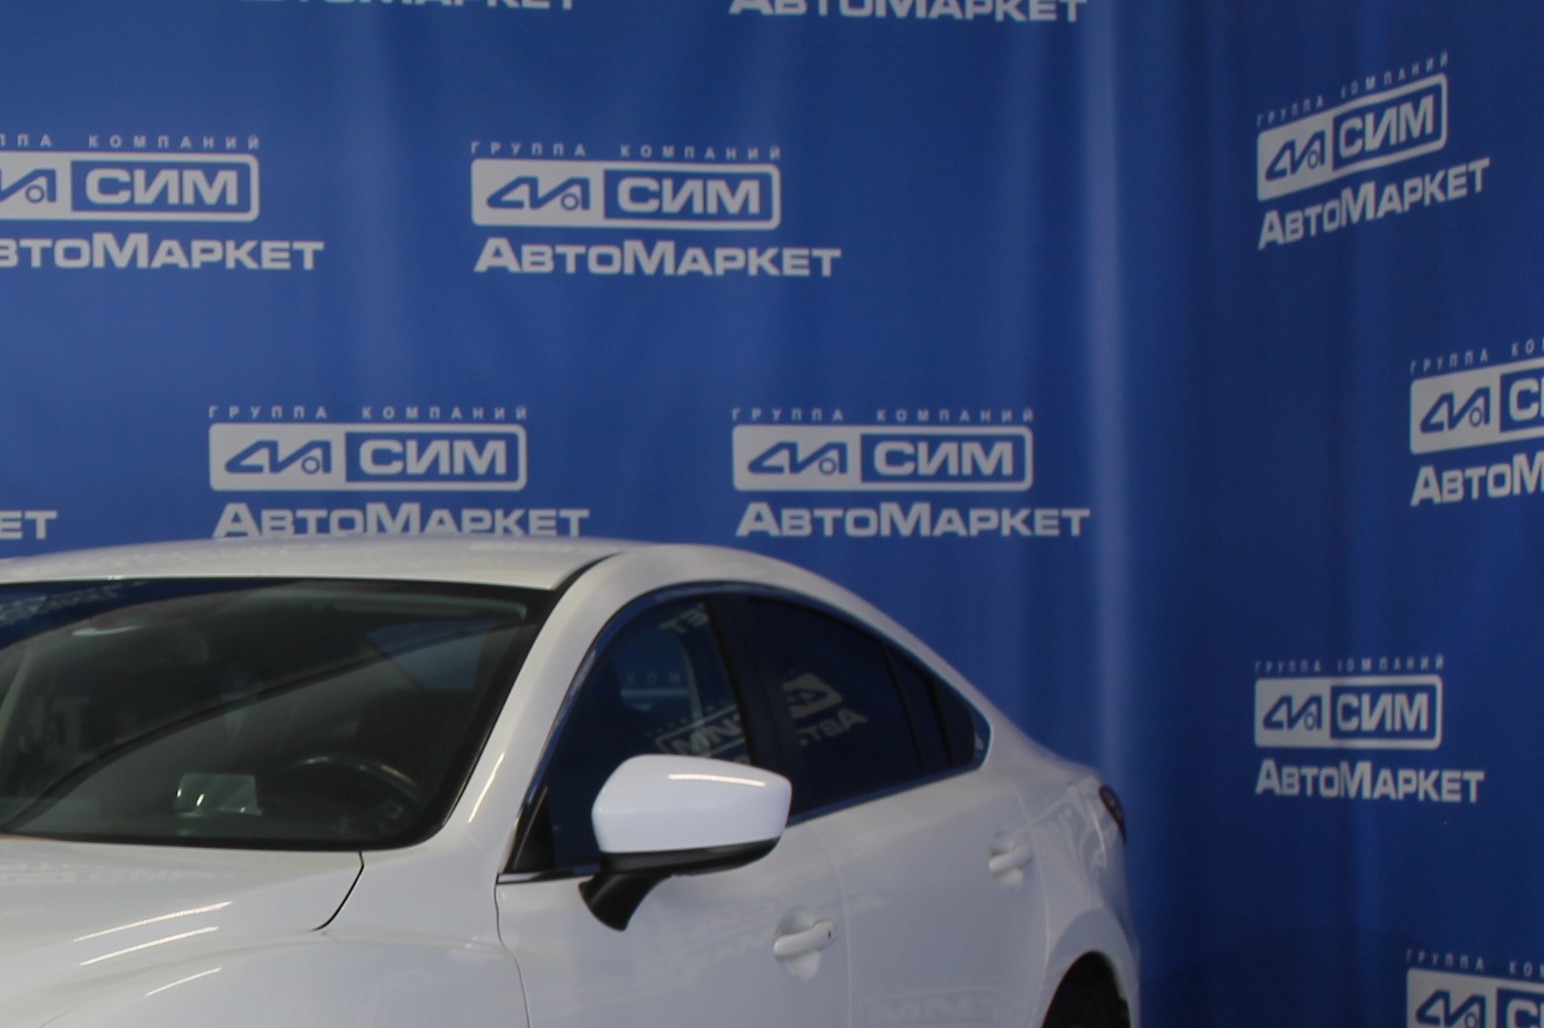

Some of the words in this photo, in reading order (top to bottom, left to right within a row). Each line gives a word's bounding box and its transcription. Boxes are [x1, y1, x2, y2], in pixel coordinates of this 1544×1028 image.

[89, 135, 259, 149] КОМПАНИЙ
[1339, 95, 1434, 158] СИМ
[471, 141, 585, 156] ГРУППА
[621, 145, 780, 159] КОМПАНИЙ
[86, 168, 237, 204] СИМ
[618, 177, 760, 213] СИМ
[209, 405, 326, 418] ГРУППА
[362, 406, 526, 419] КОМПАНИЙ
[732, 408, 843, 420] ГРУППА
[877, 409, 1033, 422] КОМПАНИЙ
[360, 439, 506, 474] СИМ
[875, 441, 1013, 475] СИМ
[1338, 693, 1428, 731] СИМ
